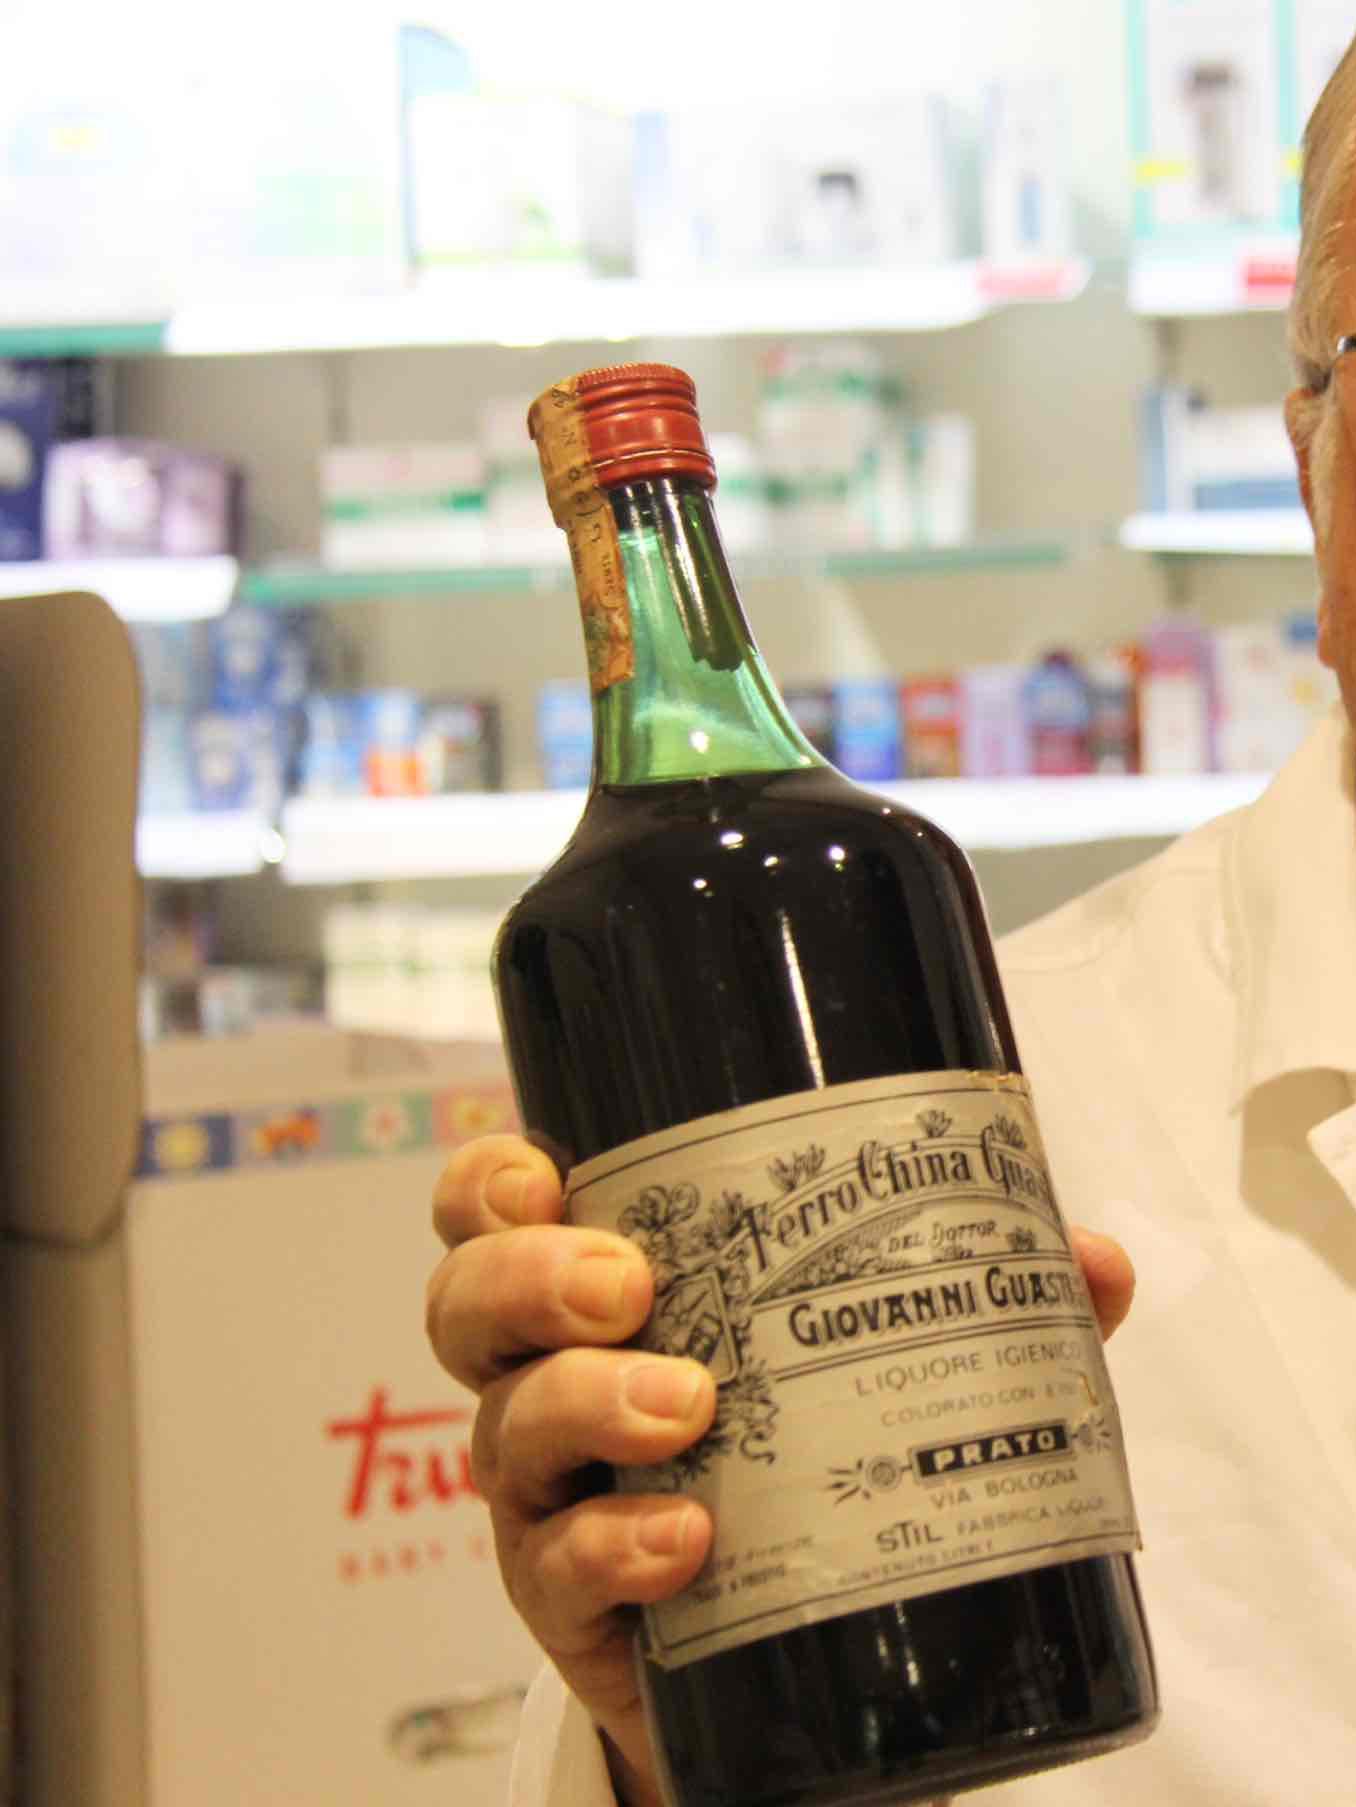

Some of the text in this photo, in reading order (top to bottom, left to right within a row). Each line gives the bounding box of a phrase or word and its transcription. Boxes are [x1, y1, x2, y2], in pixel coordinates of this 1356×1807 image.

[737, 1177, 861, 1271] Ferro
[857, 1138, 973, 1200] China
[887, 1234, 924, 1253] DEL
[788, 1281, 979, 1347] GIOVANNI
[854, 1352, 985, 1397] LIQUORE
[933, 1429, 1056, 1472] PRATO
[932, 1469, 1079, 1509] VIA BOLOGNA
